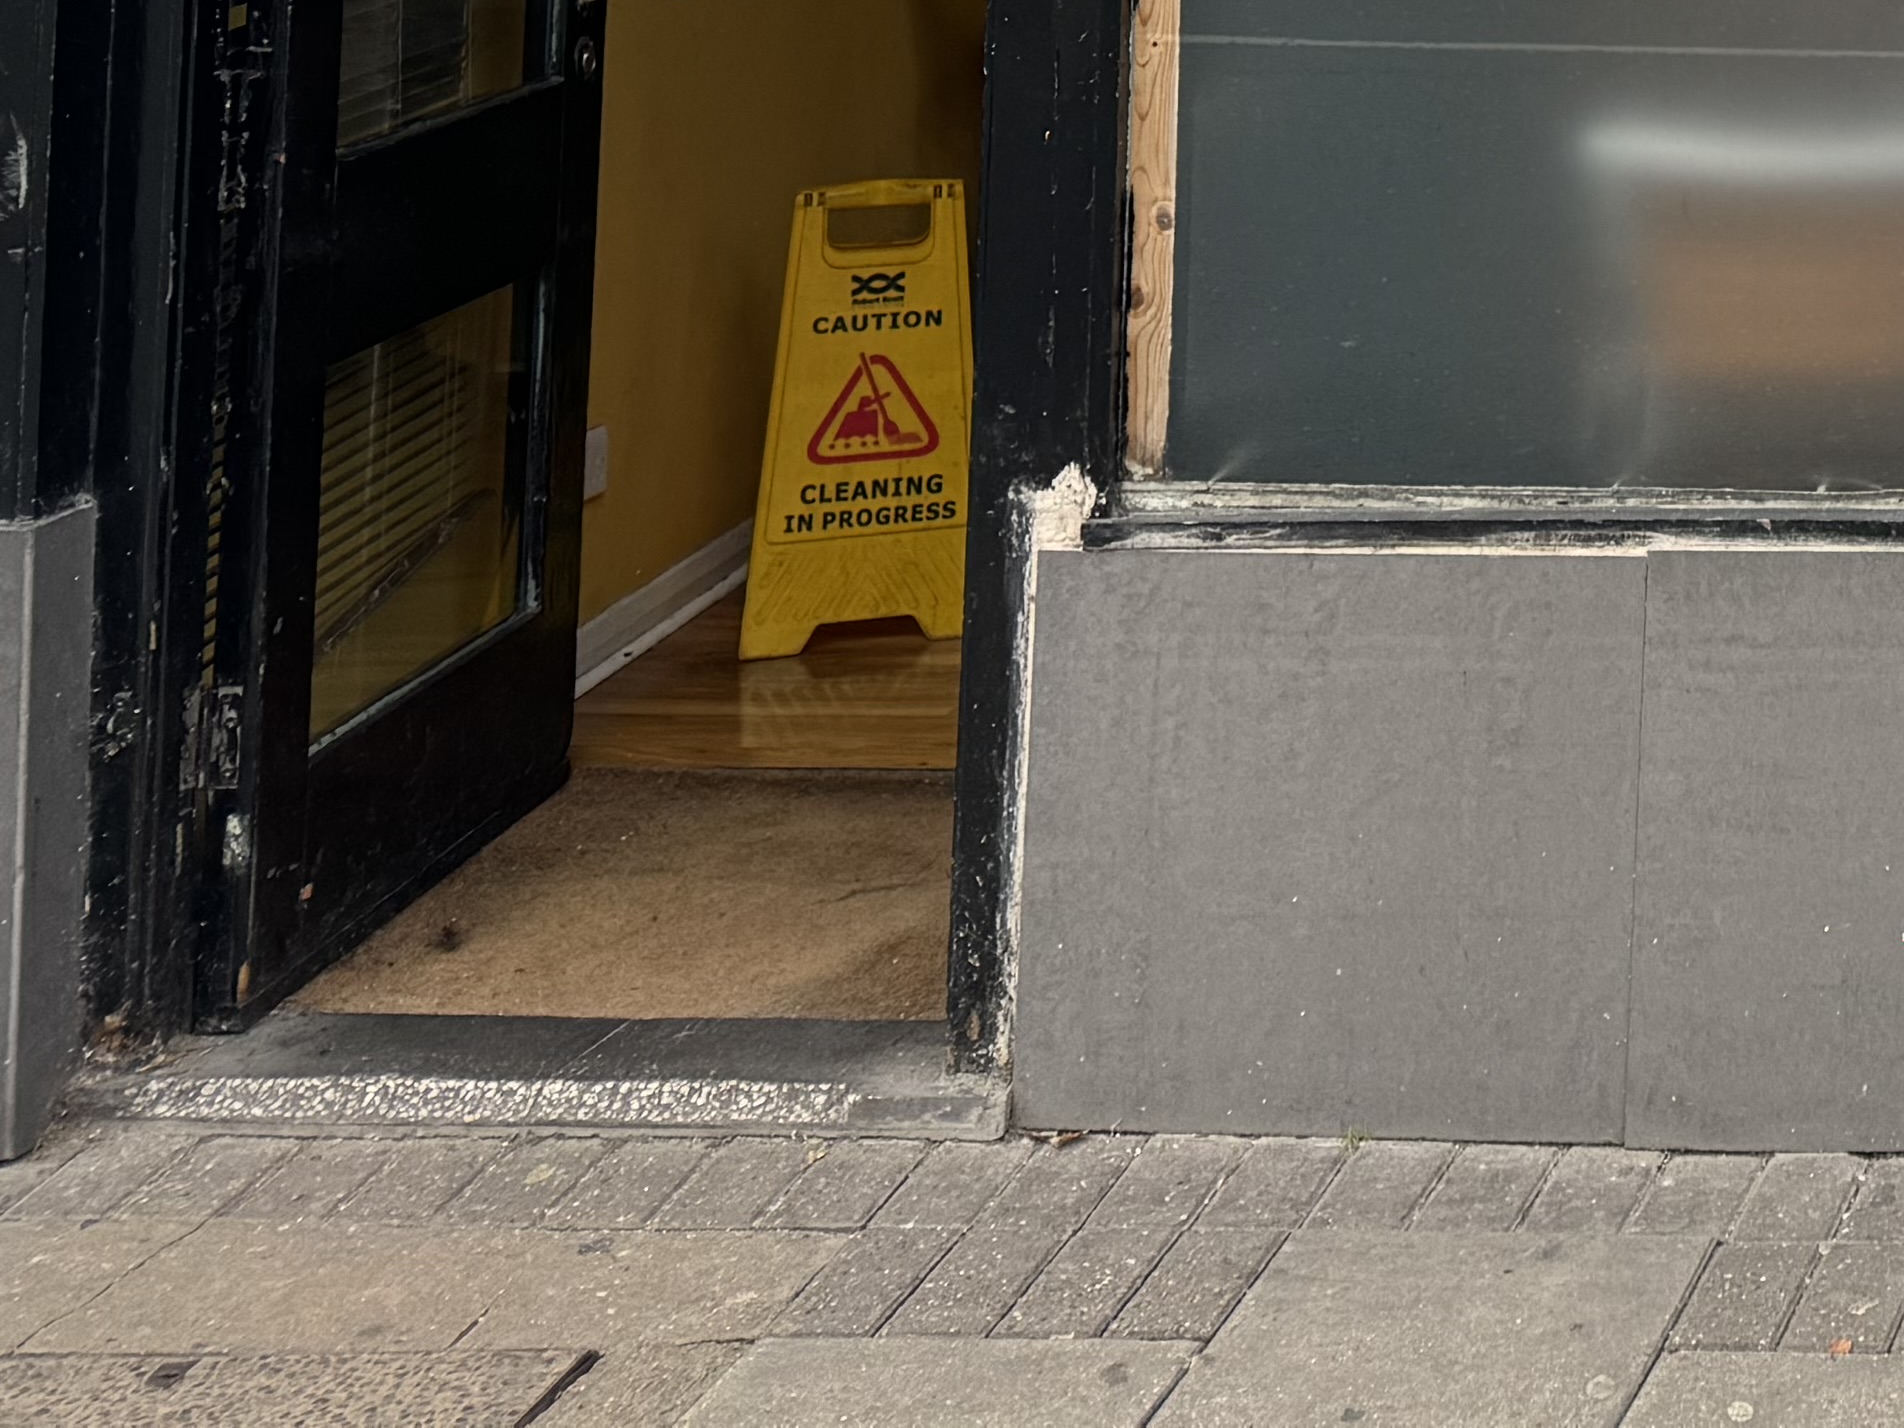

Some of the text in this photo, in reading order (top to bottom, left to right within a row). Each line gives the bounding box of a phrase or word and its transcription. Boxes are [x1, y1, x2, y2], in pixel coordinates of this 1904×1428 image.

[812, 310, 944, 334] CAUTION
[800, 474, 944, 505] CLEANING
[783, 501, 957, 534] IN PROGRESS
